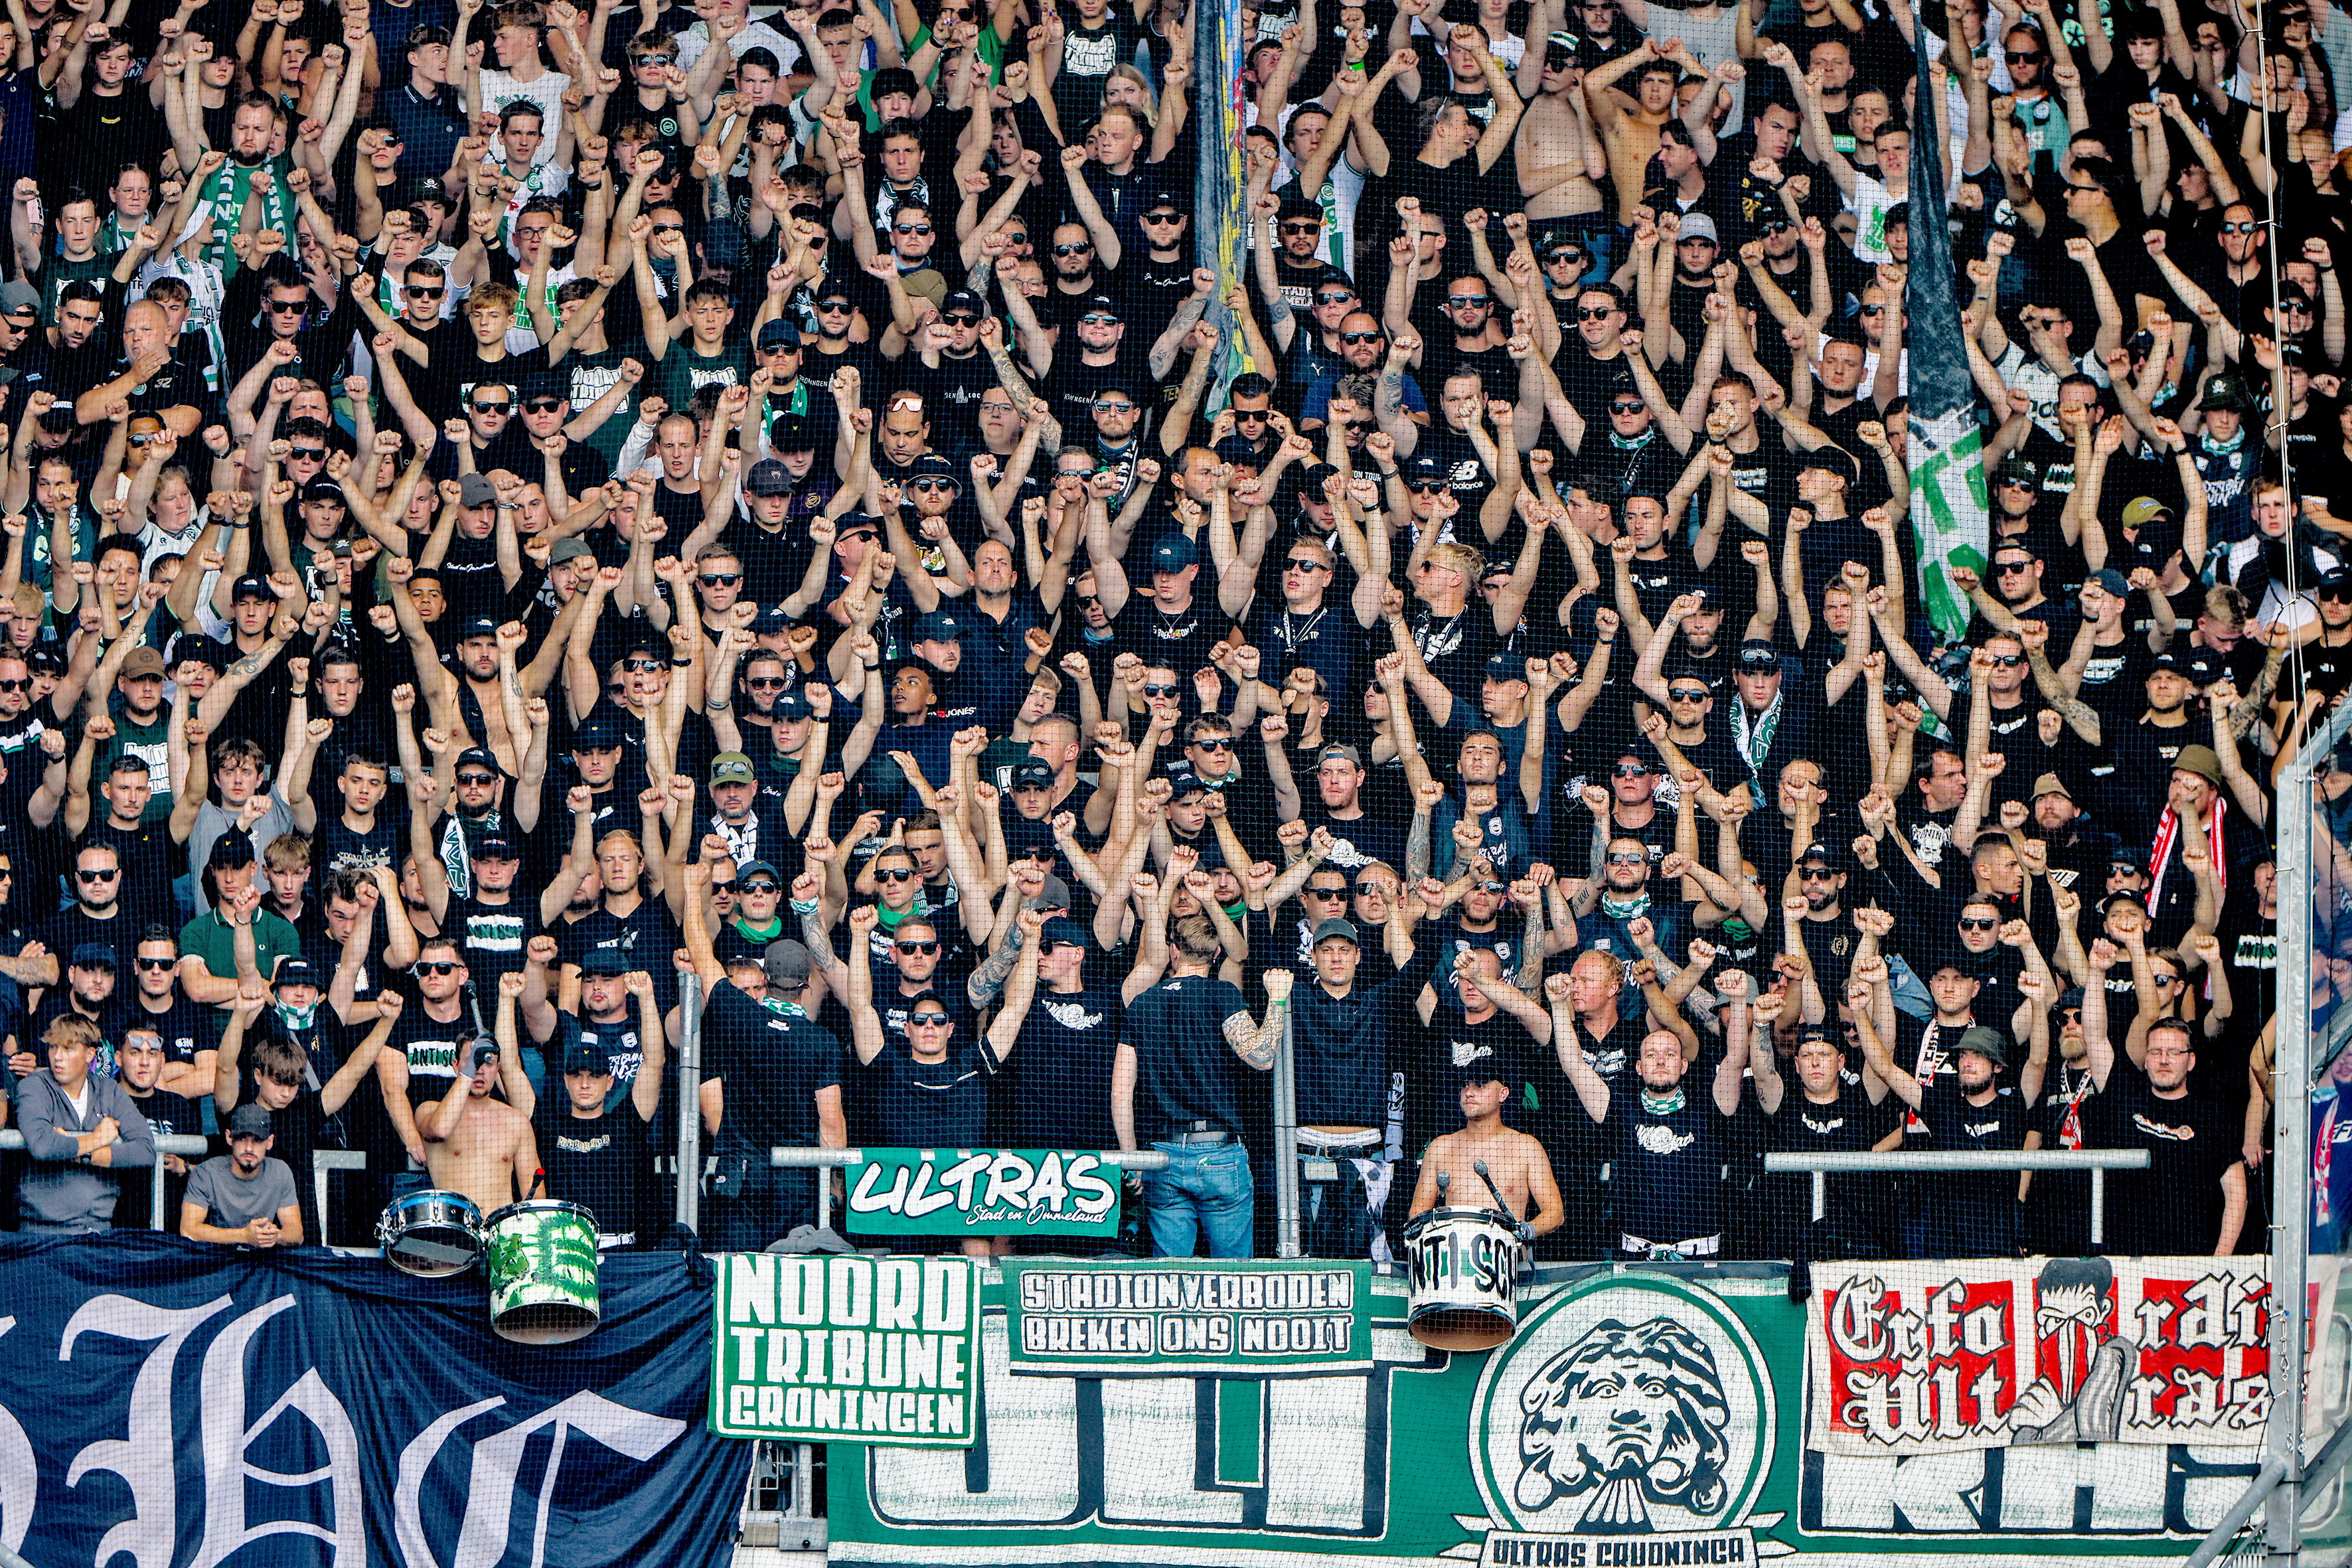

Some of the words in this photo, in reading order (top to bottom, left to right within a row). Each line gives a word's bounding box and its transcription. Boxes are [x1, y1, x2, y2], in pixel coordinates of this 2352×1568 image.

[154, 376, 173, 388] 32
[1452, 481, 1483, 491] balance
[412, 1048, 439, 1066] ANTI
[850, 1150, 1117, 1217] ULTRAS
[966, 1204, 1003, 1225] Stad
[1006, 1208, 1024, 1221] en
[1026, 1202, 1107, 1225] Ommeland
[728, 1255, 969, 1330] NOORD
[1021, 1273, 1352, 1311] STADIONVERBODEN
[2135, 1271, 2272, 1350] rdi
[1024, 1315, 1152, 1353] BREKEN
[1160, 1316, 1233, 1353] ONS
[1239, 1316, 1352, 1353] NOOIT
[729, 1326, 967, 1390] TRIBUNE
[729, 1384, 965, 1436] GRONINGEN
[1494, 1539, 1587, 1568] ULTRAS
